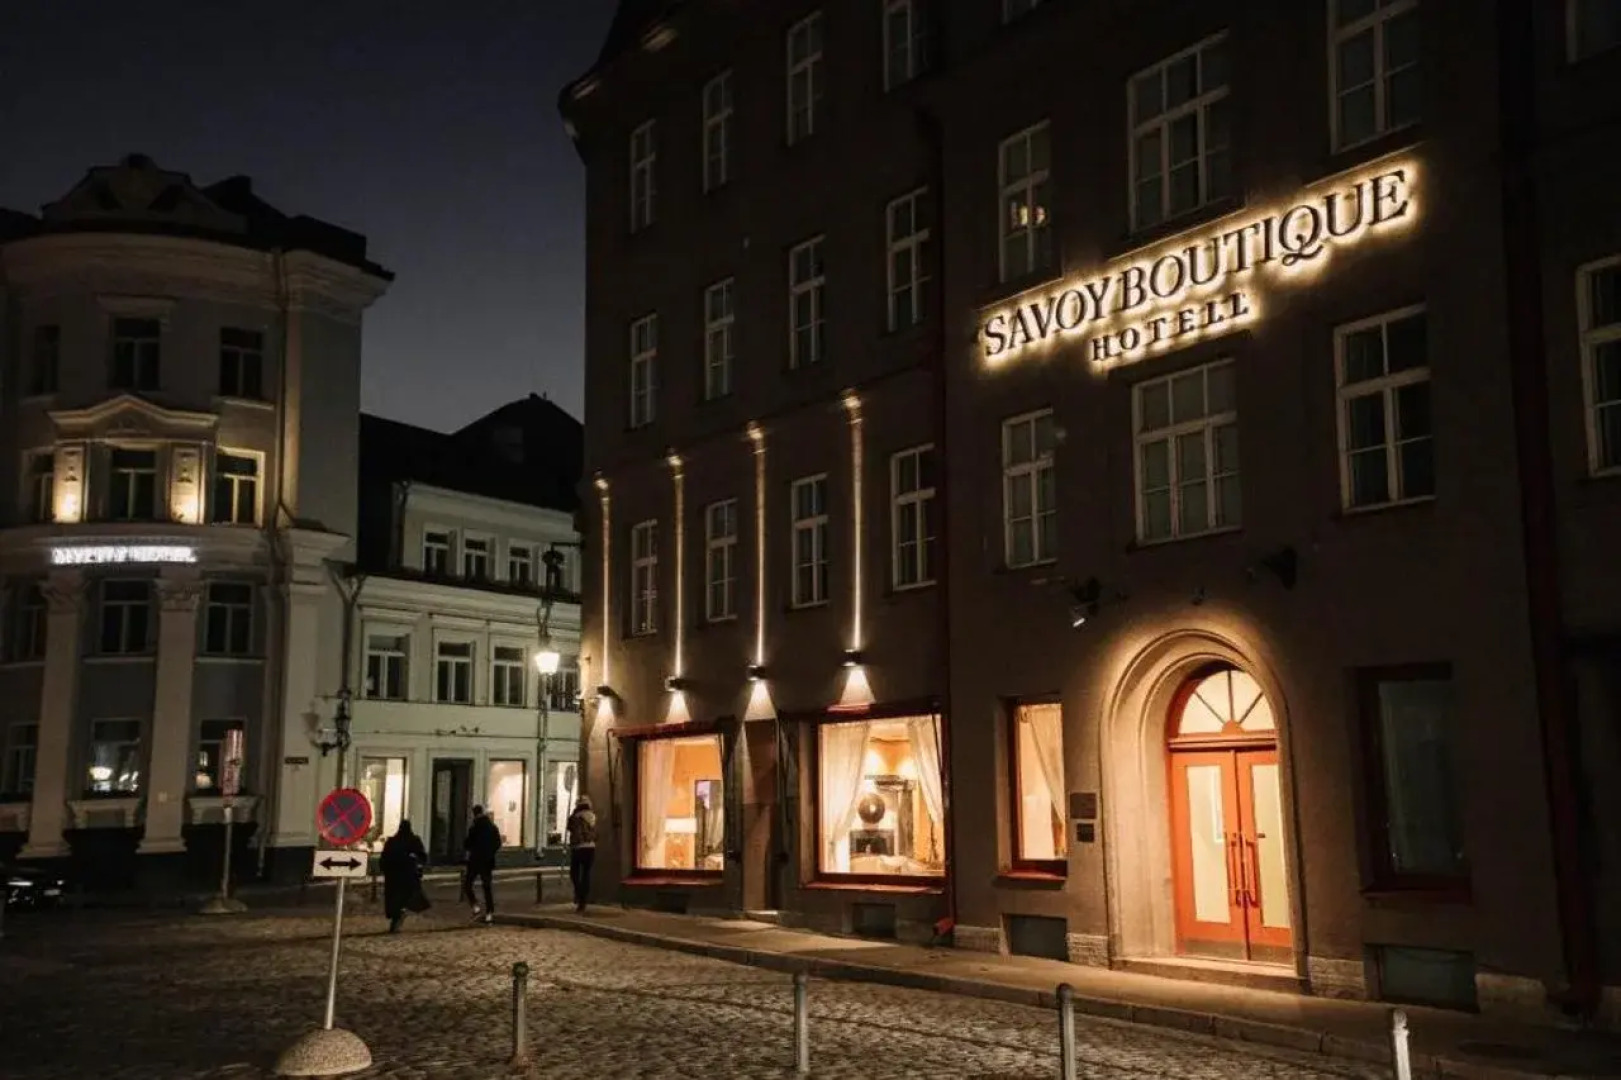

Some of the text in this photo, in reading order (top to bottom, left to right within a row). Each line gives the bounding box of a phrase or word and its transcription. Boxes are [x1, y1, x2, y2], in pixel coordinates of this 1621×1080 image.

[984, 170, 1407, 356] SAVOY BOUTIQUE
[1092, 292, 1248, 360] HOTELL
